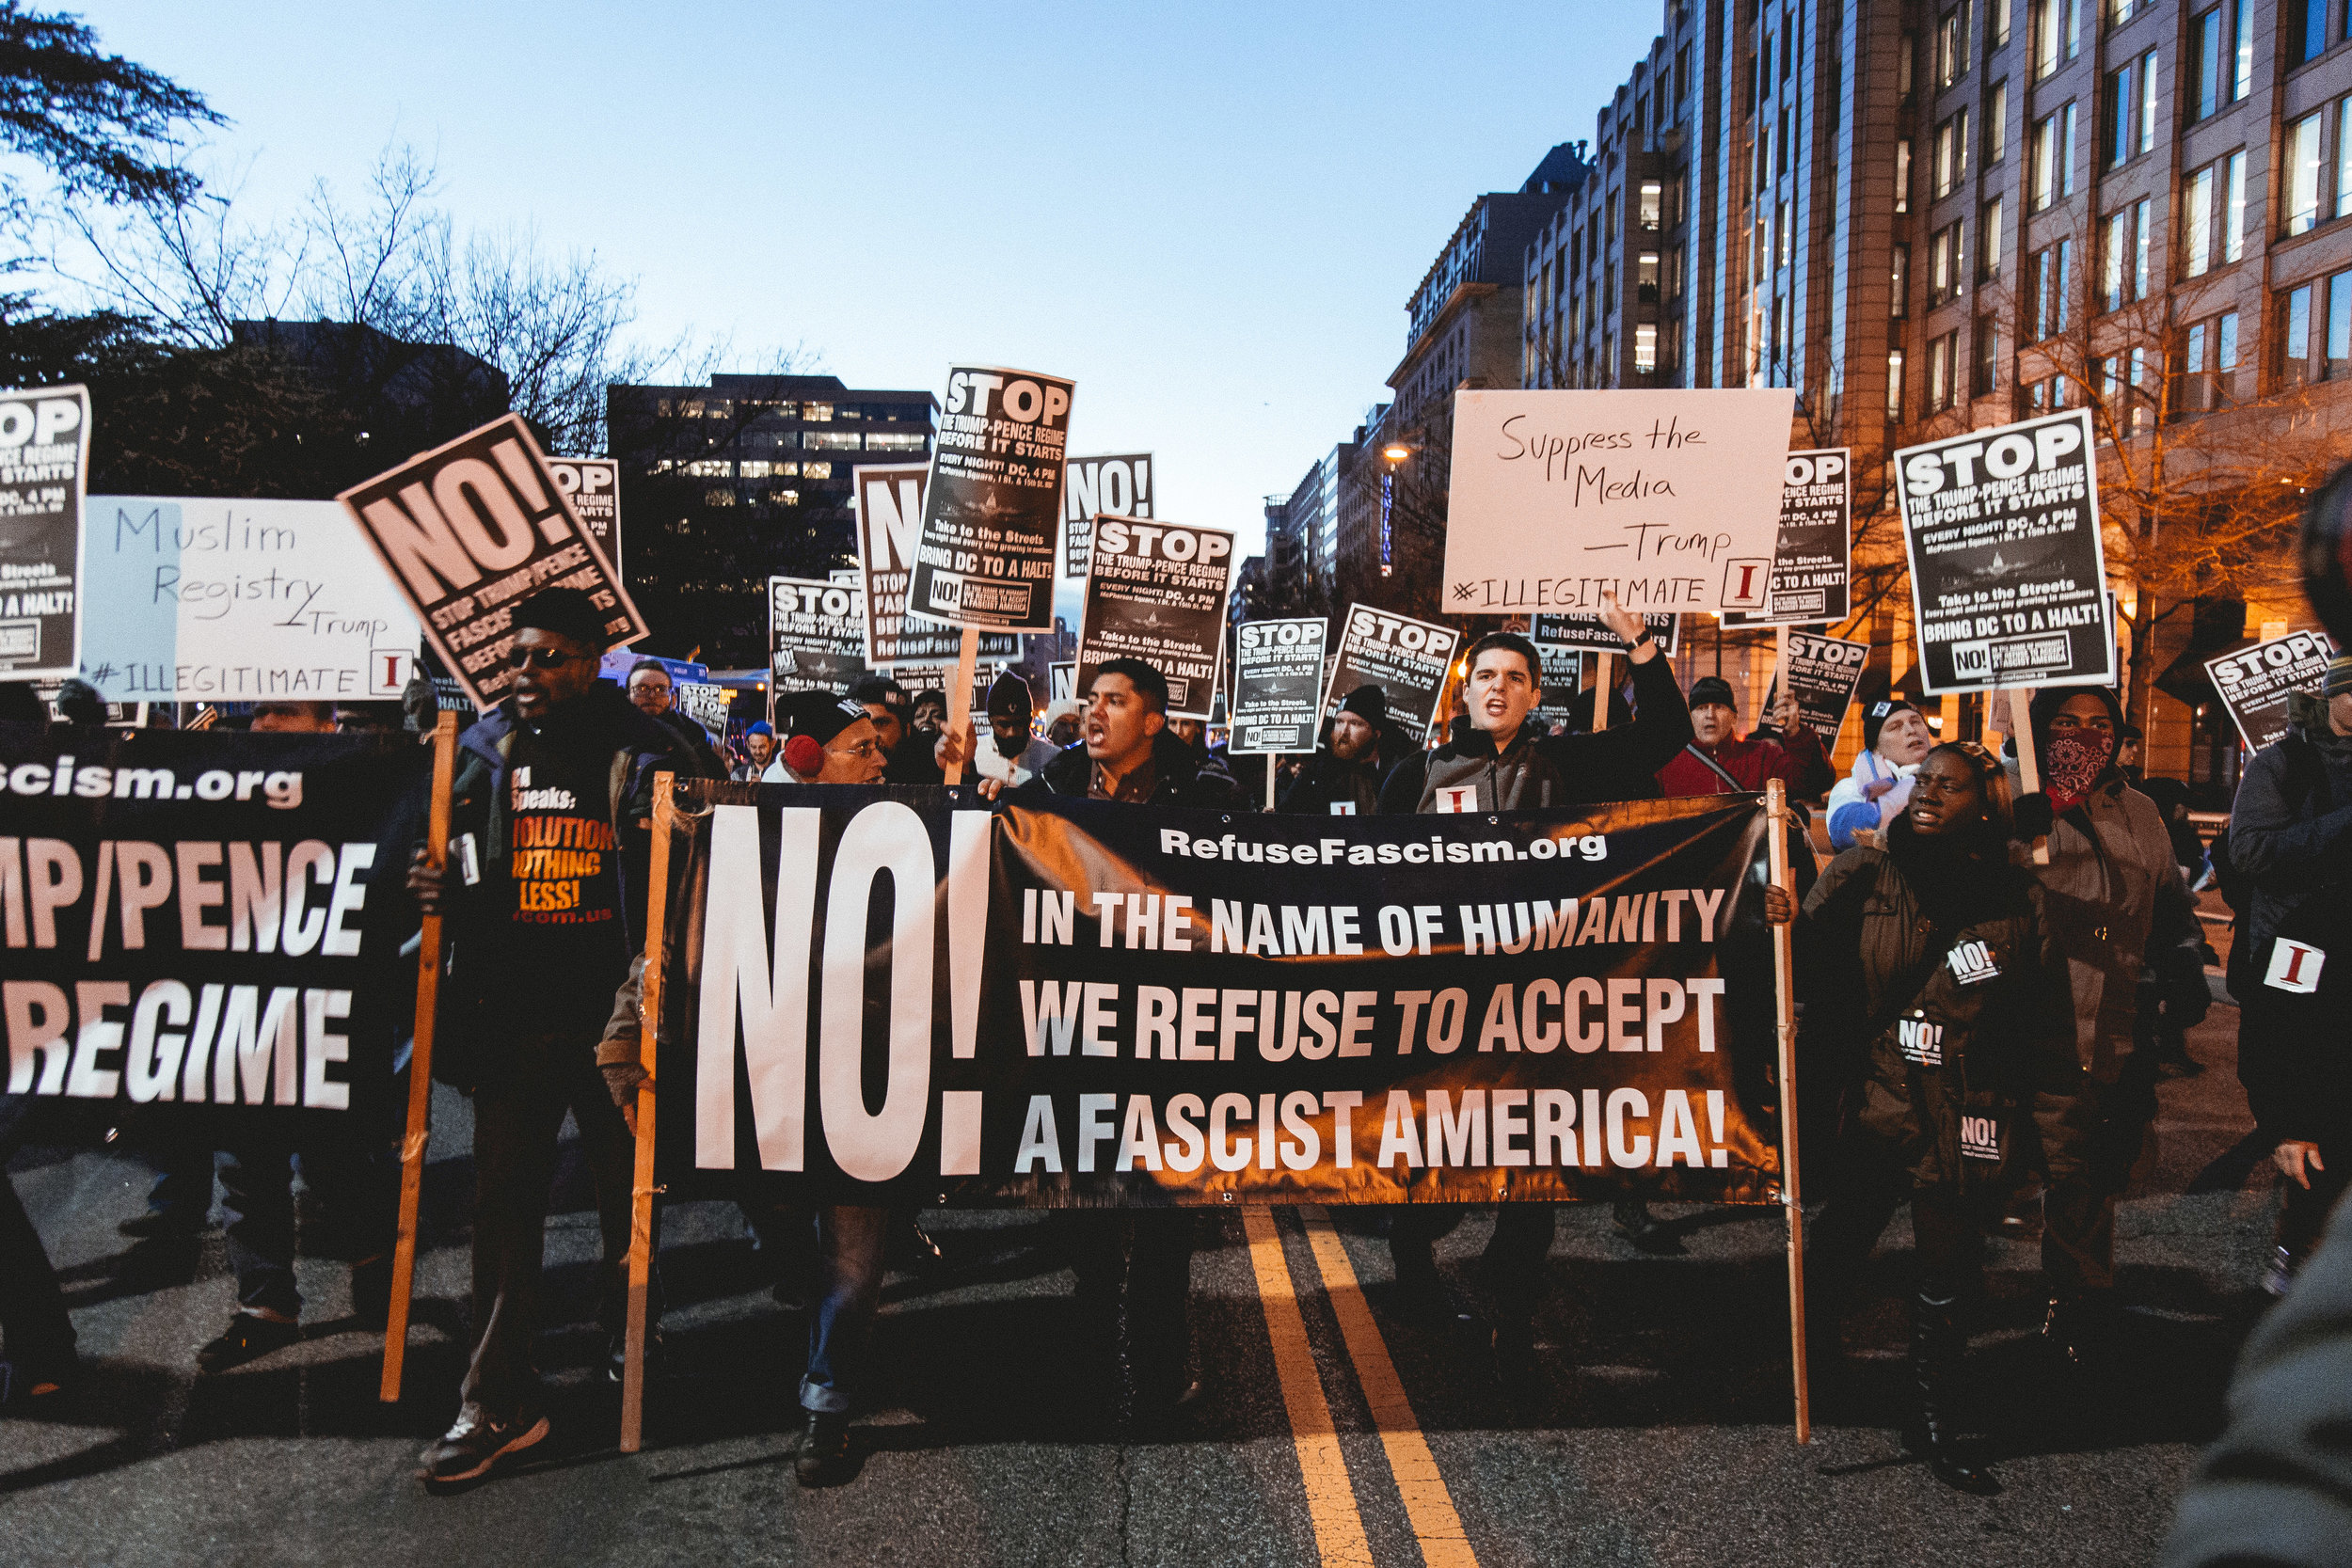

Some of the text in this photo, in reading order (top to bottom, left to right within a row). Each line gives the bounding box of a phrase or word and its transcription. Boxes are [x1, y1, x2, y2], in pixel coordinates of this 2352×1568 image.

[947, 372, 1068, 426] STOP
[0, 400, 81, 448] OP
[955, 415, 1032, 441] TRUMP-PENCE
[939, 432, 1063, 461] BEFORE IT STARTS
[1498, 415, 1707, 481] Suppress the
[1906, 423, 2082, 497] STOP
[551, 465, 612, 494] OP
[1785, 456, 1844, 485] OP
[577, 494, 613, 506] REGIME
[1067, 460, 1149, 520] NO!
[1575, 465, 1676, 507] Media
[1810, 483, 1844, 497] REGIME
[1908, 465, 2085, 515] THE TRUMP-PENCE REGIME
[1792, 510, 1837, 522] DC, 4 PM
[1795, 496, 1844, 508] STARTS
[1912, 483, 2085, 529] BEFORE IT STARTS
[117, 508, 294, 552] Muslim
[362, 437, 572, 606] NO!
[591, 521, 607, 530] PM
[935, 519, 1044, 545] Take to the Streets
[1069, 522, 1090, 534] STOP
[1923, 508, 2077, 545] EVERY NIGHT! DC, 4 PM
[1098, 522, 1231, 564] STOP
[919, 544, 1053, 578] BRING DC TO HALT!
[1095, 552, 1227, 579] THE TRUMP-PENCE REGIME
[1778, 555, 1833, 566] the Streets
[431, 595, 474, 630] STOP
[473, 543, 591, 609] TRUMP/PENCE
[873, 573, 907, 594] STOP
[932, 579, 959, 603] NO!
[1094, 565, 1223, 591] BEFORE IT STARTS
[1453, 578, 1705, 608] #ILLEGITIMATE
[1735, 566, 1757, 599] I
[1783, 572, 1845, 588] TO A HALT!
[1938, 578, 2075, 608] Take to the Streets
[6, 592, 72, 617] A HALT!
[154, 565, 323, 626] Registry
[1199, 594, 1216, 605] PM
[1979, 589, 2094, 611] every numbers
[445, 607, 513, 653] FASCIS
[775, 610, 788, 623] THE
[775, 621, 816, 635] BEFORE
[1924, 603, 2100, 643] BRING DC TO A HALT!
[1241, 624, 1323, 648] STOP
[1352, 611, 1453, 655] STOP
[1345, 643, 1442, 676] BEFORE STARTS
[1347, 633, 1447, 669] THE TRUMP-PENCE REGIME
[1553, 658, 1578, 667] REGIME
[1788, 636, 1864, 665] STOP
[1956, 650, 1987, 671] NO!
[2215, 637, 2312, 685] STOP
[94, 663, 358, 694] #ILLEGITIMATE
[383, 657, 402, 687] I
[785, 676, 804, 687] Take
[1177, 661, 1213, 680] HALT!
[1824, 672, 1855, 682] STARTS
[2223, 665, 2295, 695] THE TRUMP-PENCE
[2228, 664, 2328, 703] BEFORE STARTS
[683, 686, 719, 697] STOP
[1259, 714, 1314, 724] DC TO HALT!
[1816, 724, 1836, 736] HALT!
[1248, 732, 1261, 742] NO!
[513, 816, 613, 850] OLUTION
[1160, 829, 1608, 865] RefuseFascism.org
[0, 837, 376, 961] P/PENCE
[520, 879, 580, 911] LESS!
[513, 909, 612, 924] com.us
[1023, 888, 1725, 957] IN THE NAME OF HUMANITY
[1947, 941, 1994, 975] NO!
[2280, 945, 2312, 985] I
[695, 800, 993, 1183] NO!
[1019, 977, 1725, 1063] WE REFUSE TO ACCEPT
[3, 978, 352, 1110] REGIME
[1899, 1020, 1943, 1053] NO!
[1014, 1087, 1729, 1174] A FASCIST AMERICA!
[1962, 1117, 1996, 1147] NO!
